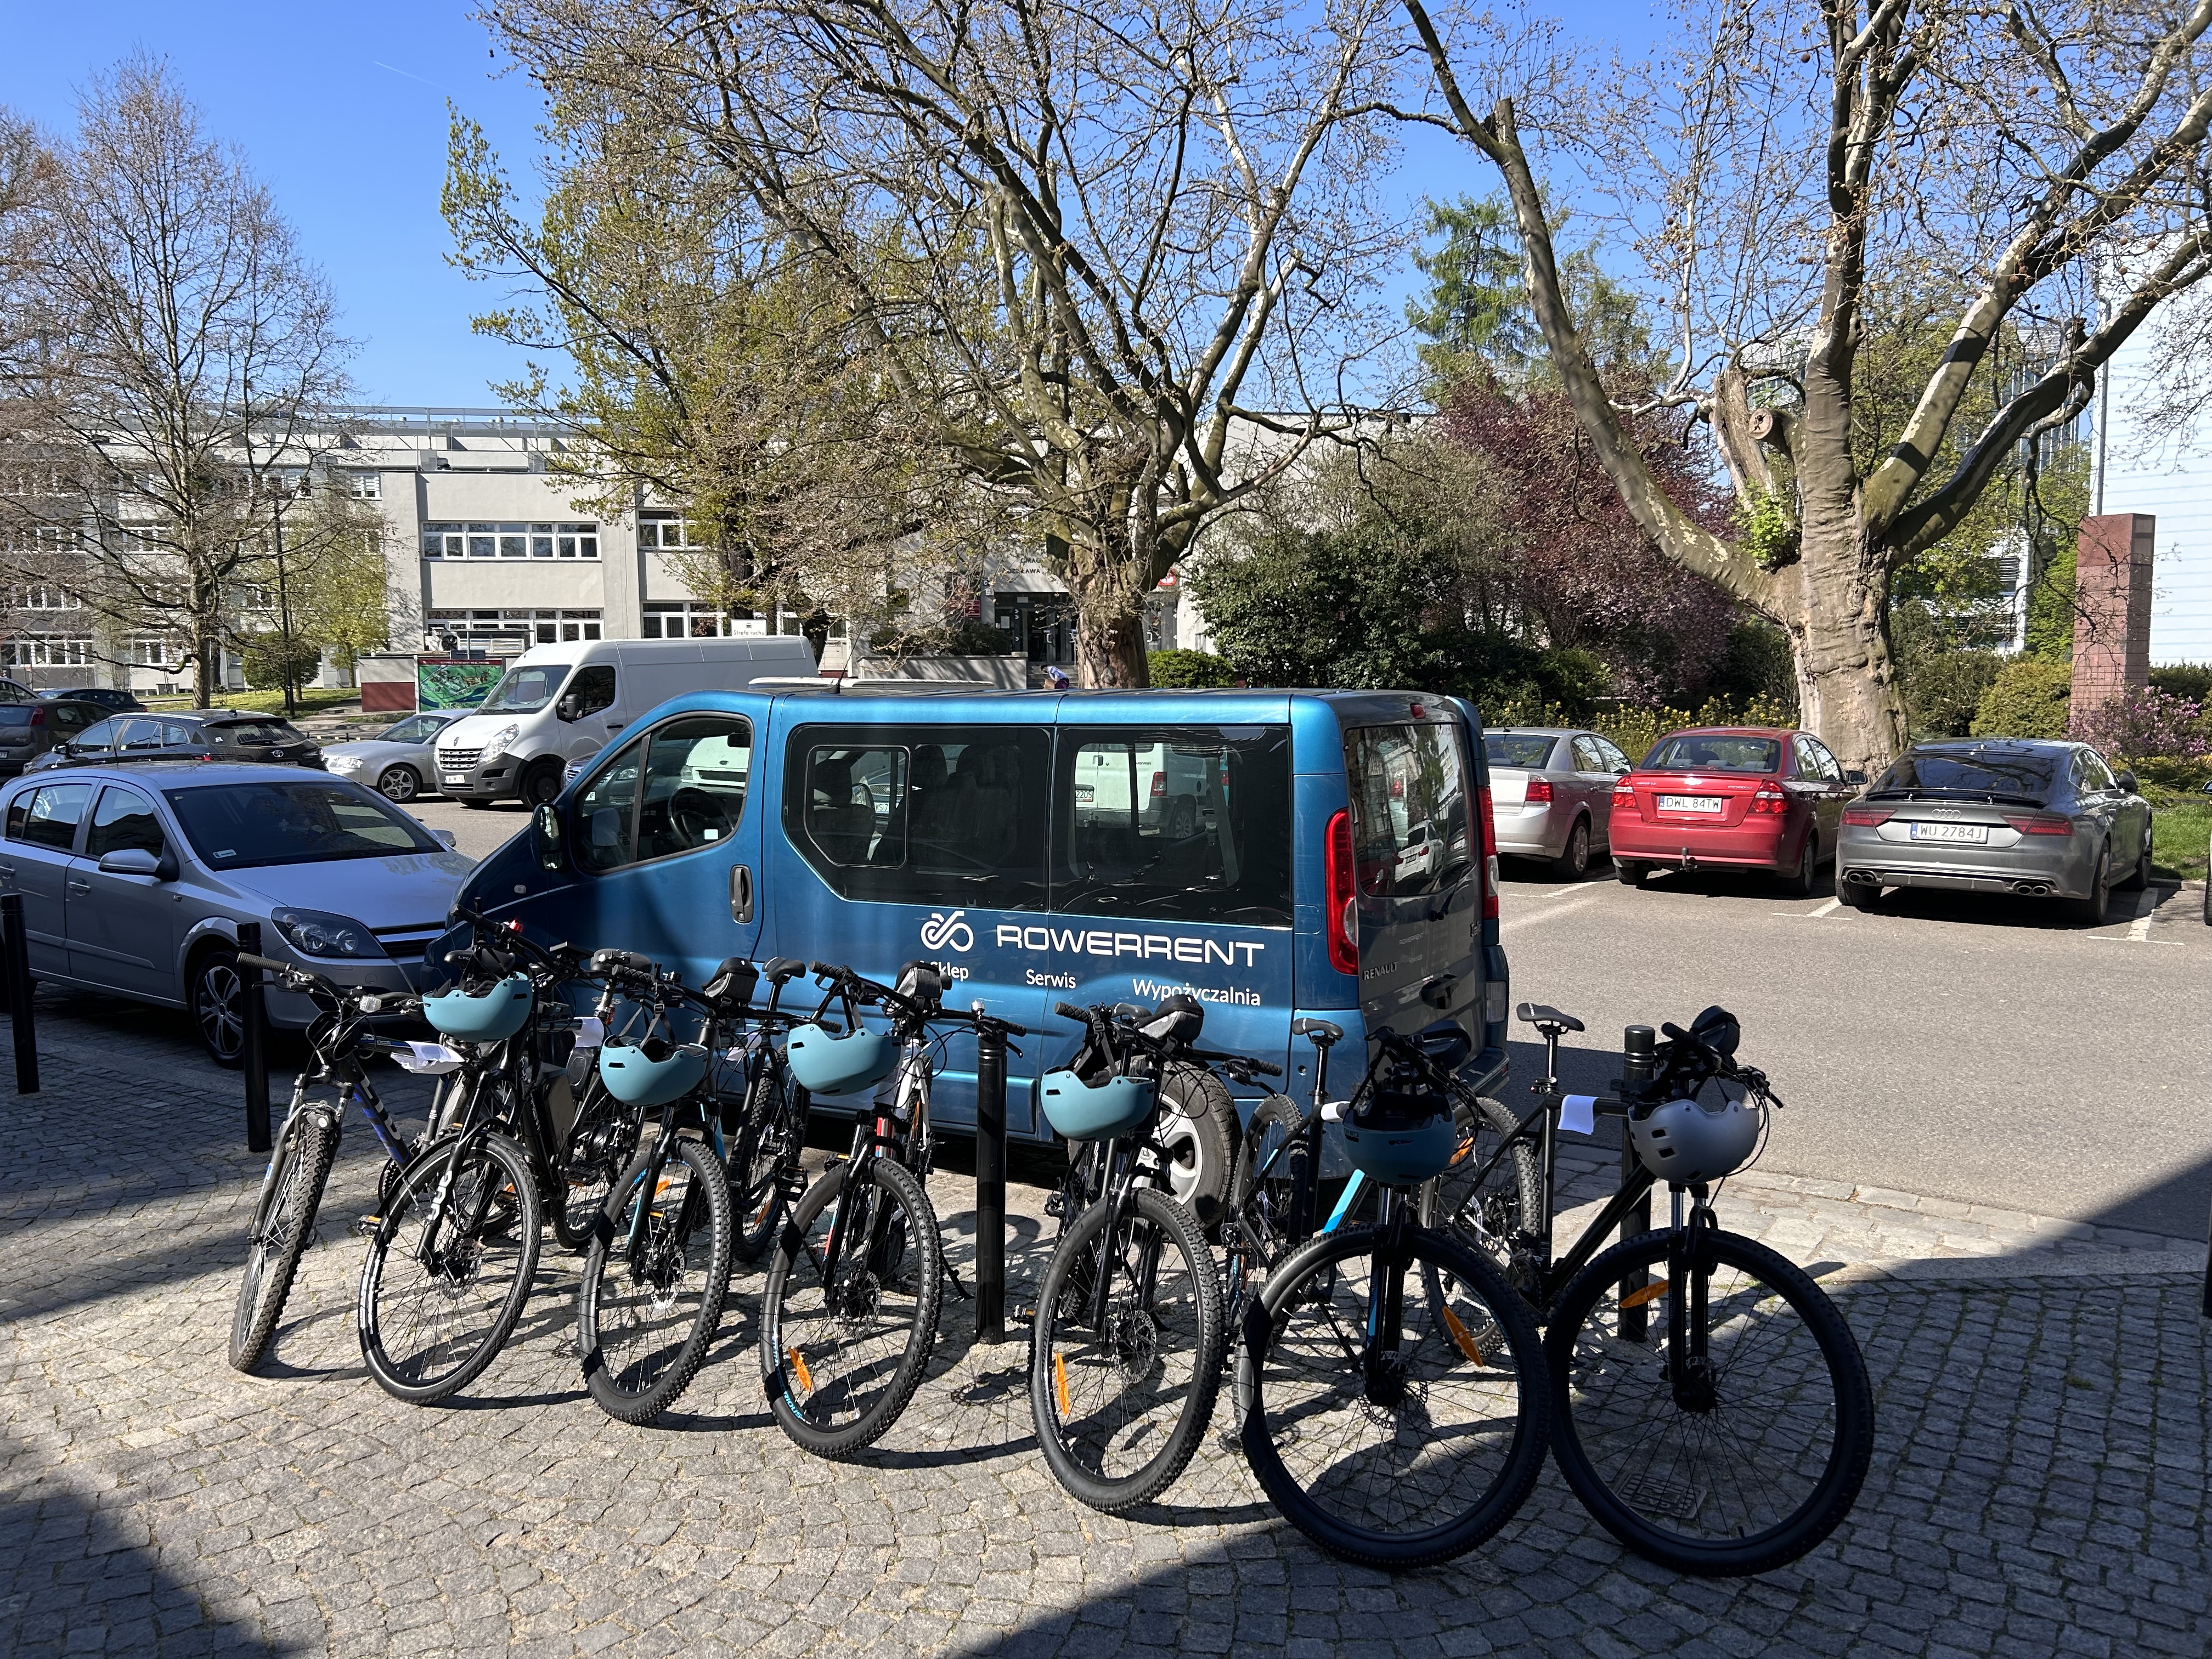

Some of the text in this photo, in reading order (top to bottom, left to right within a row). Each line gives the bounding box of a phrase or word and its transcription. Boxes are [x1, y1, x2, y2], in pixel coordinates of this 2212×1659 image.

[1076, 790, 1092, 799] 2205
[1666, 797, 1719, 809] DWL 84TW
[1921, 825, 1982, 839] WU 2784J
[997, 924, 1265, 967] ROWERRENT
[1363, 961, 1398, 980] RENAULT
[1026, 969, 1076, 989] Serwis
